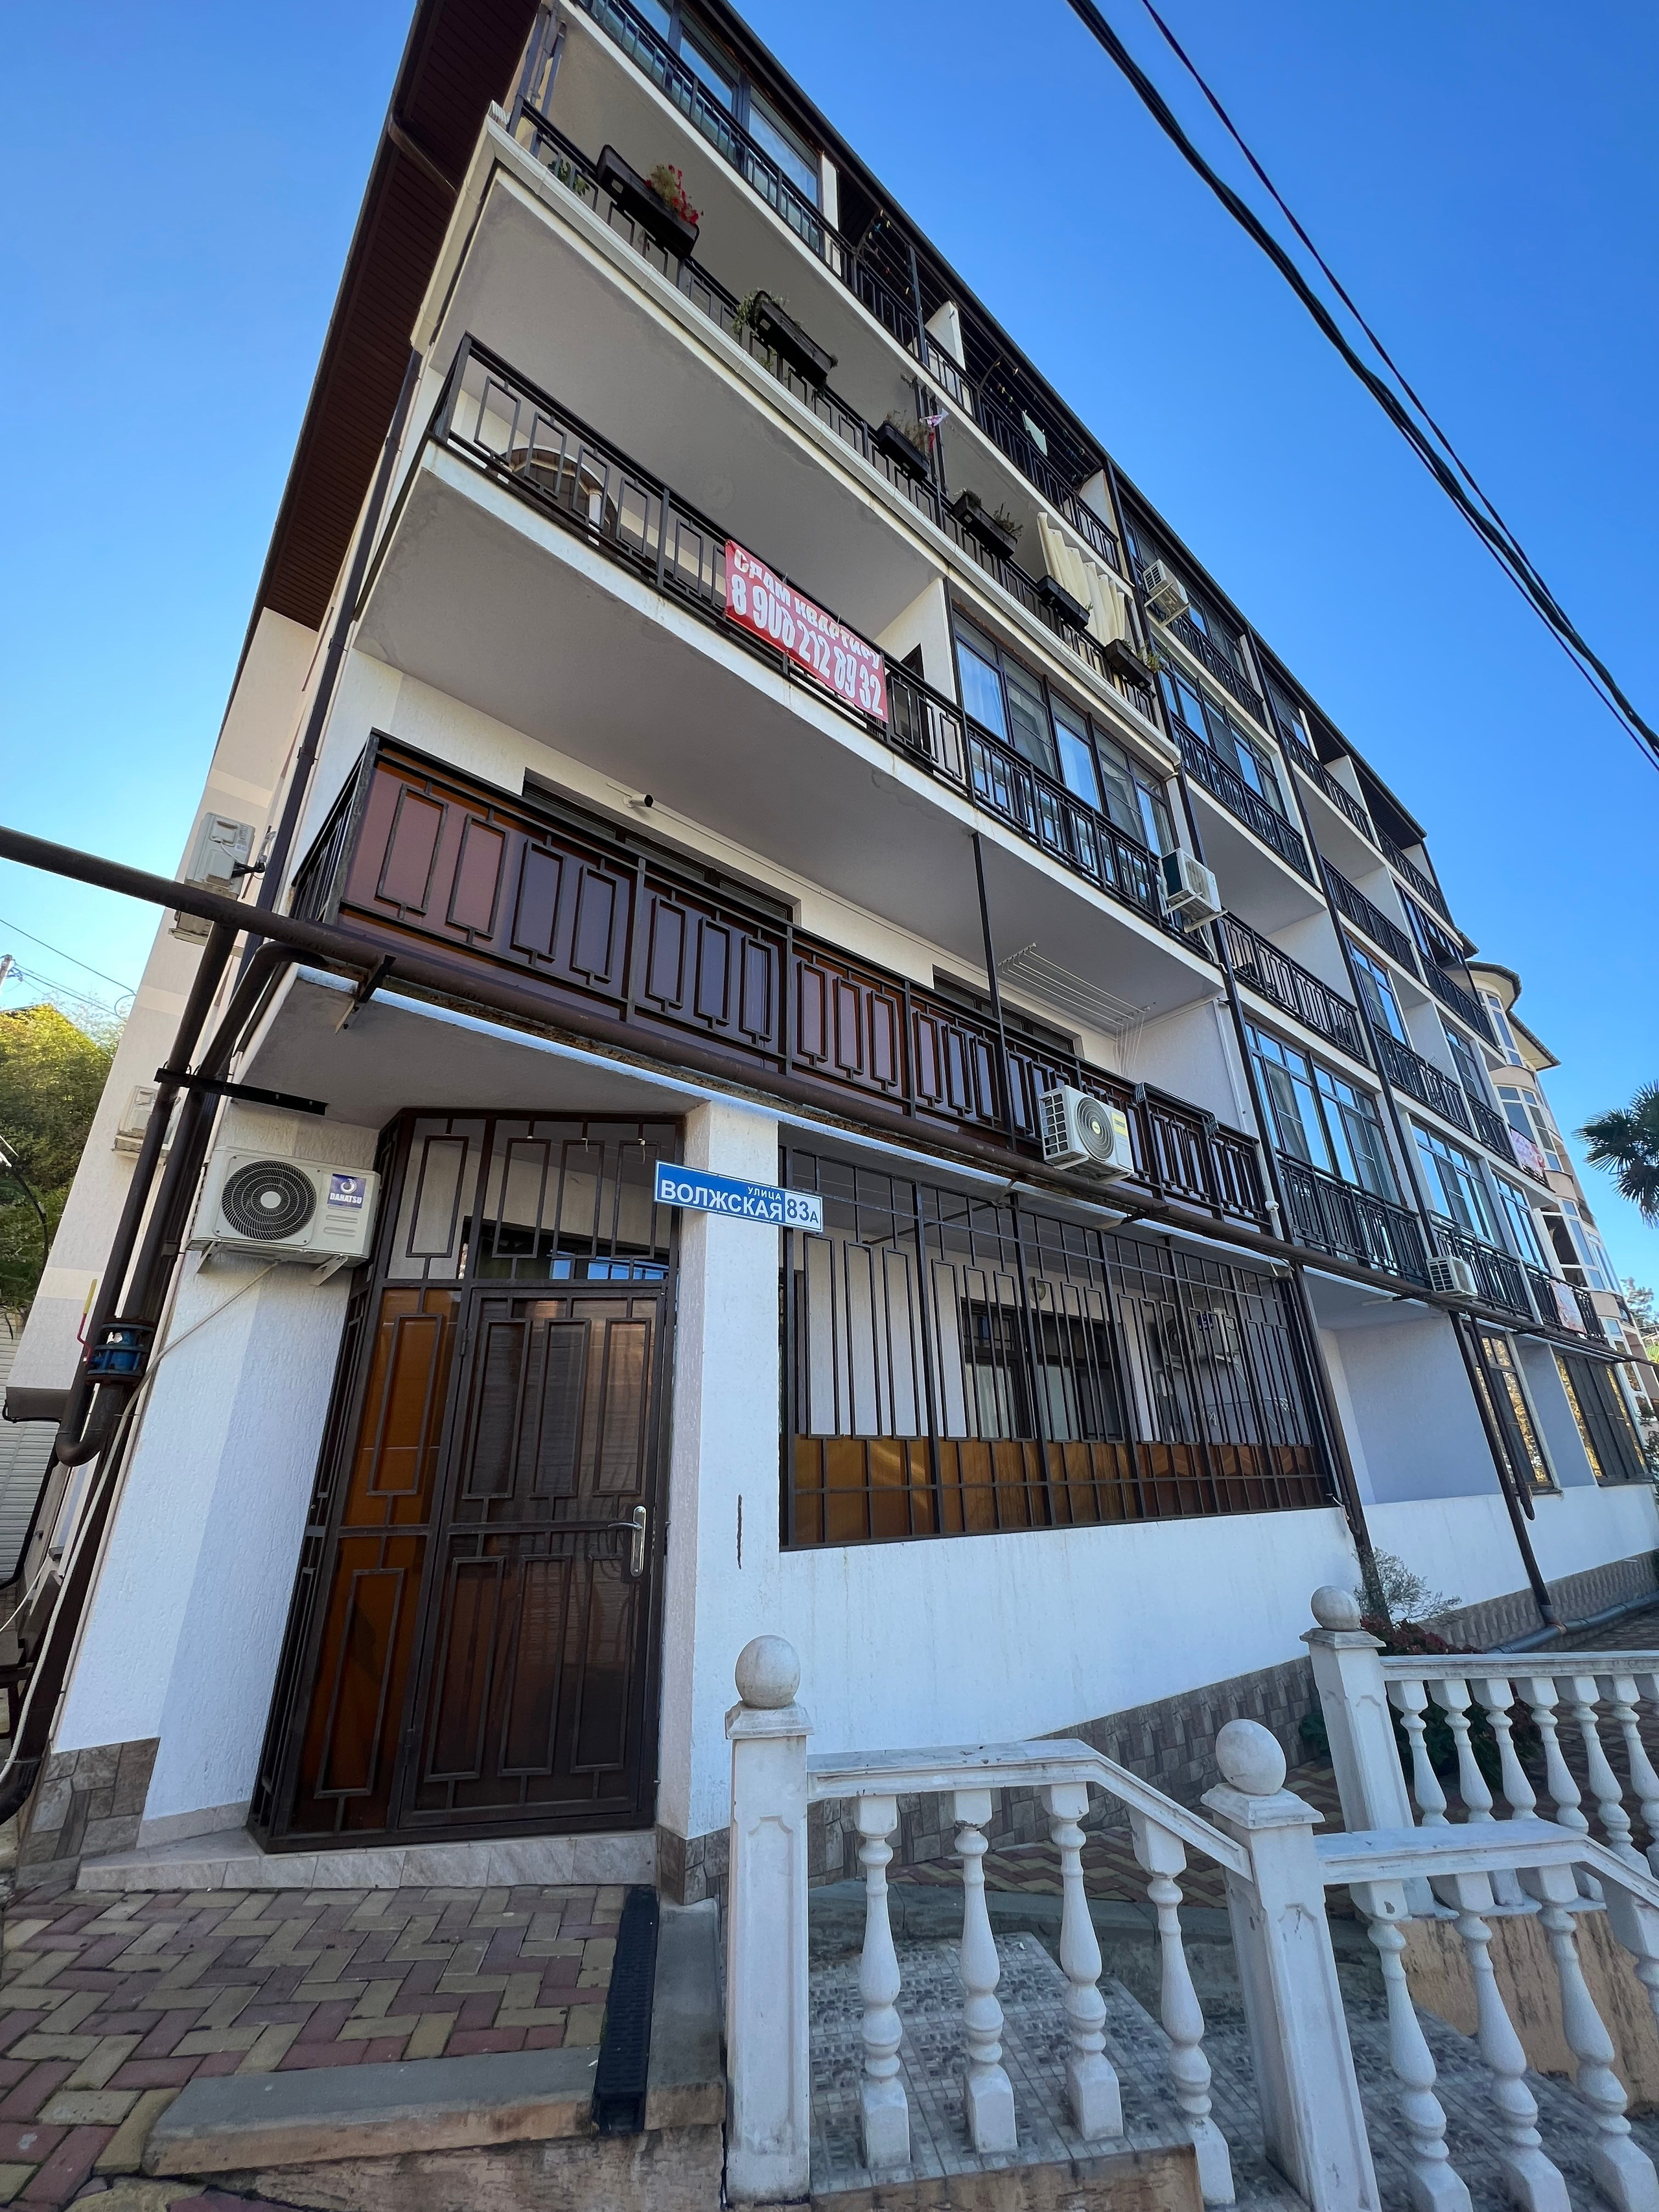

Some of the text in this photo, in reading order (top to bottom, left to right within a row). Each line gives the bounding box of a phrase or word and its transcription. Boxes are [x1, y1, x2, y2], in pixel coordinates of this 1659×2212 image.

[732, 574, 747, 615] 8
[796, 619, 830, 679] 212
[833, 646, 857, 698] 89
[859, 664, 883, 716] 32
[795, 596, 879, 669] КВАРТИРУ
[329, 1193, 362, 1204] DAHATSU
[661, 1179, 818, 1224] ВОЛЖСКАЯ 83А
[747, 1186, 782, 1201] УЛИЦА
